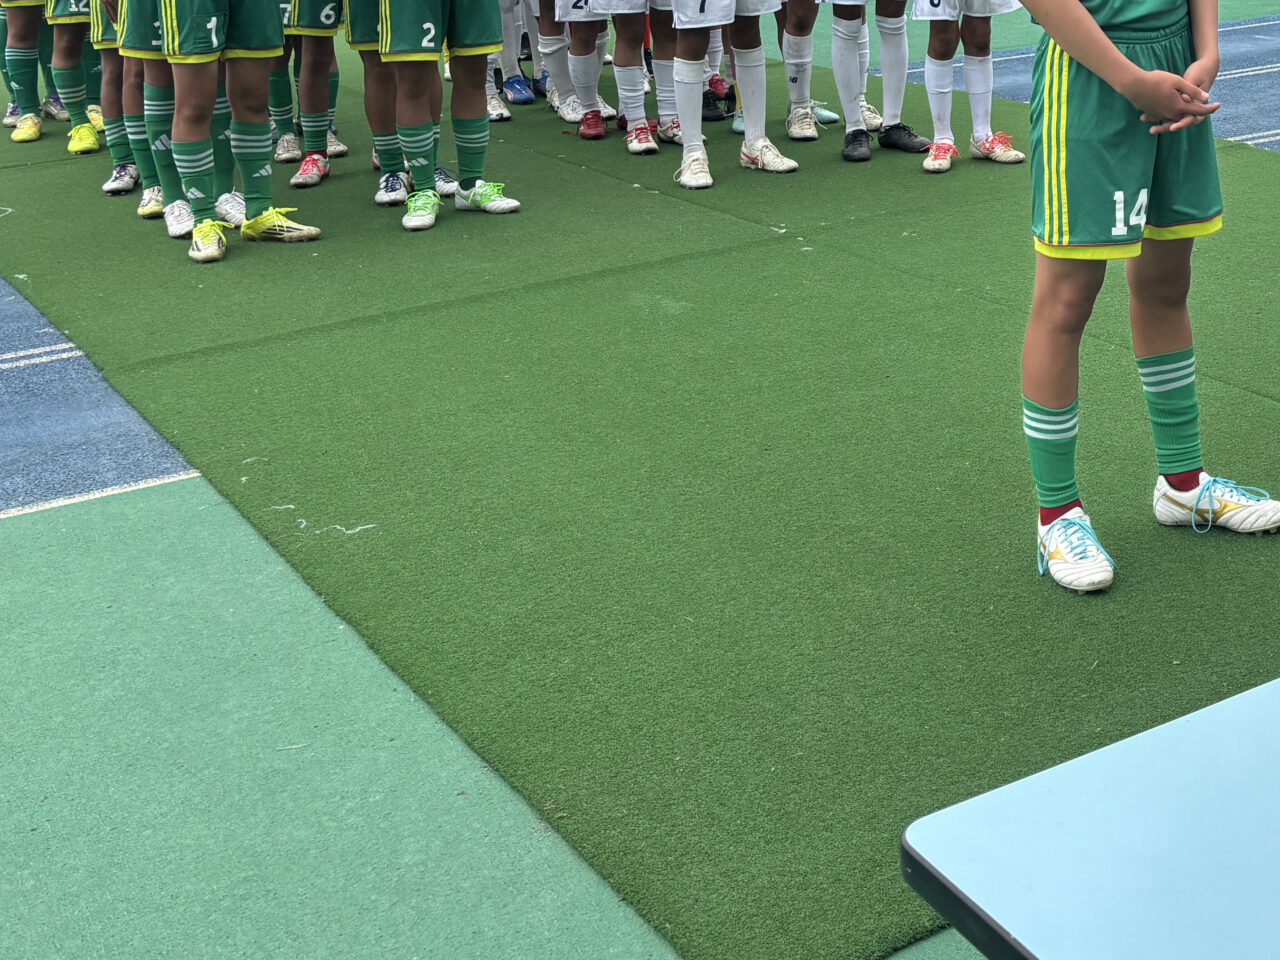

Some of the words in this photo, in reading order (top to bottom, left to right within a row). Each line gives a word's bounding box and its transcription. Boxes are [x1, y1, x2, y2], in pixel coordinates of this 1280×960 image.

[320, 2, 336, 25] 6
[206, 16, 219, 48] 1
[421, 22, 435, 48] 2
[1111, 188, 1148, 236] 14
